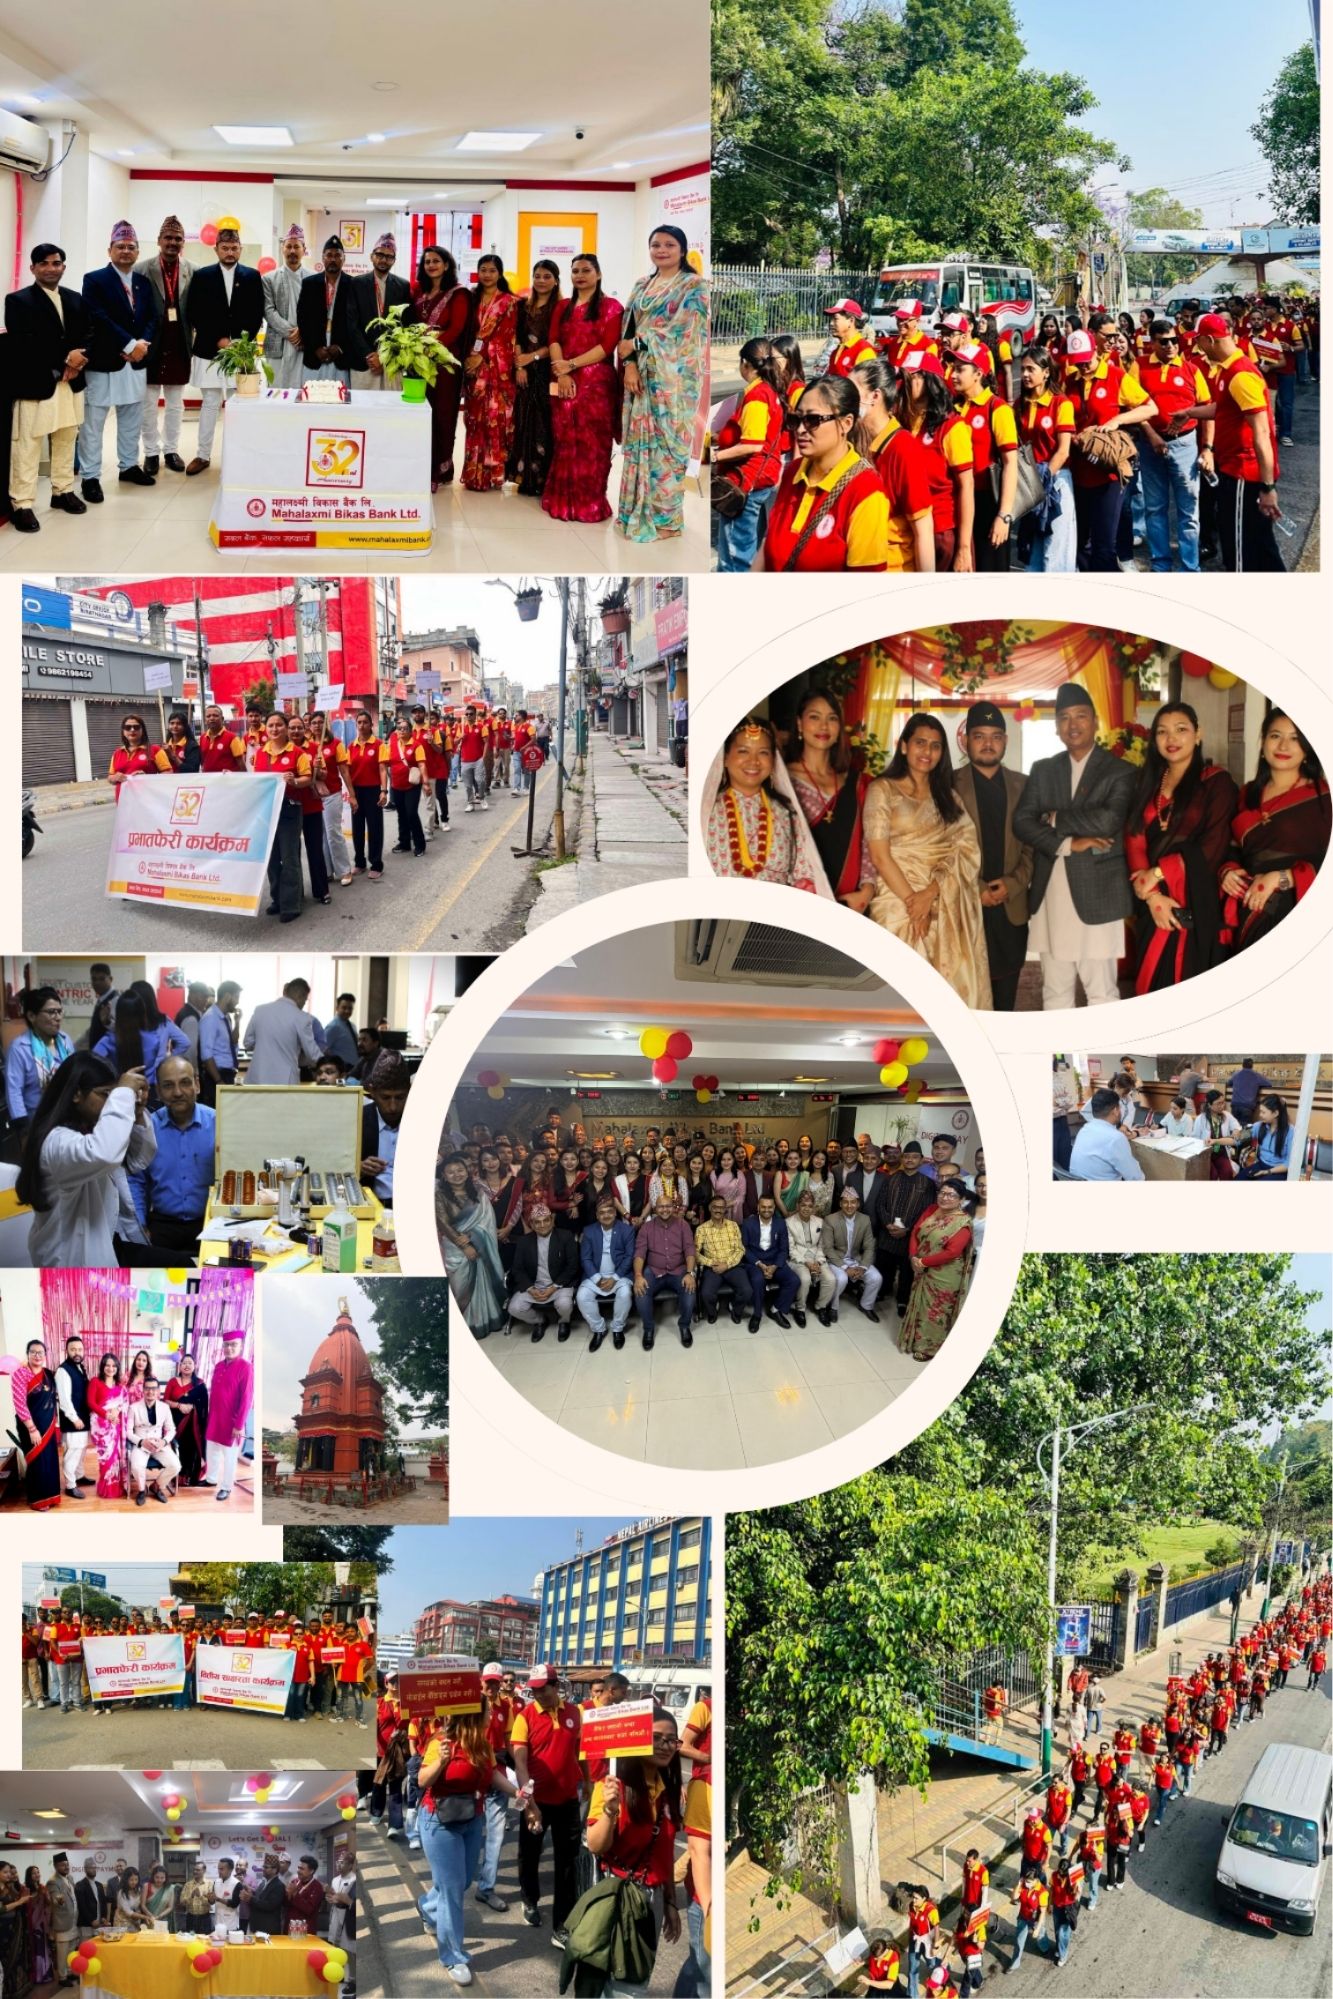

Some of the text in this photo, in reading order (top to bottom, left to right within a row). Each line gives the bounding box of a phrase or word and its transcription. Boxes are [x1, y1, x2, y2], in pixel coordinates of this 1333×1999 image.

[311, 438, 360, 477] 32
[313, 496, 339, 507] विकास
[271, 508, 421, 519] Mahalaxmi Bikas Bank Ltd.
[56, 649, 105, 666] STORE
[174, 791, 202, 818] 32
[128, 828, 251, 854] प्रभातफेरी कार्यक्रम
[191, 872, 207, 881] Bank
